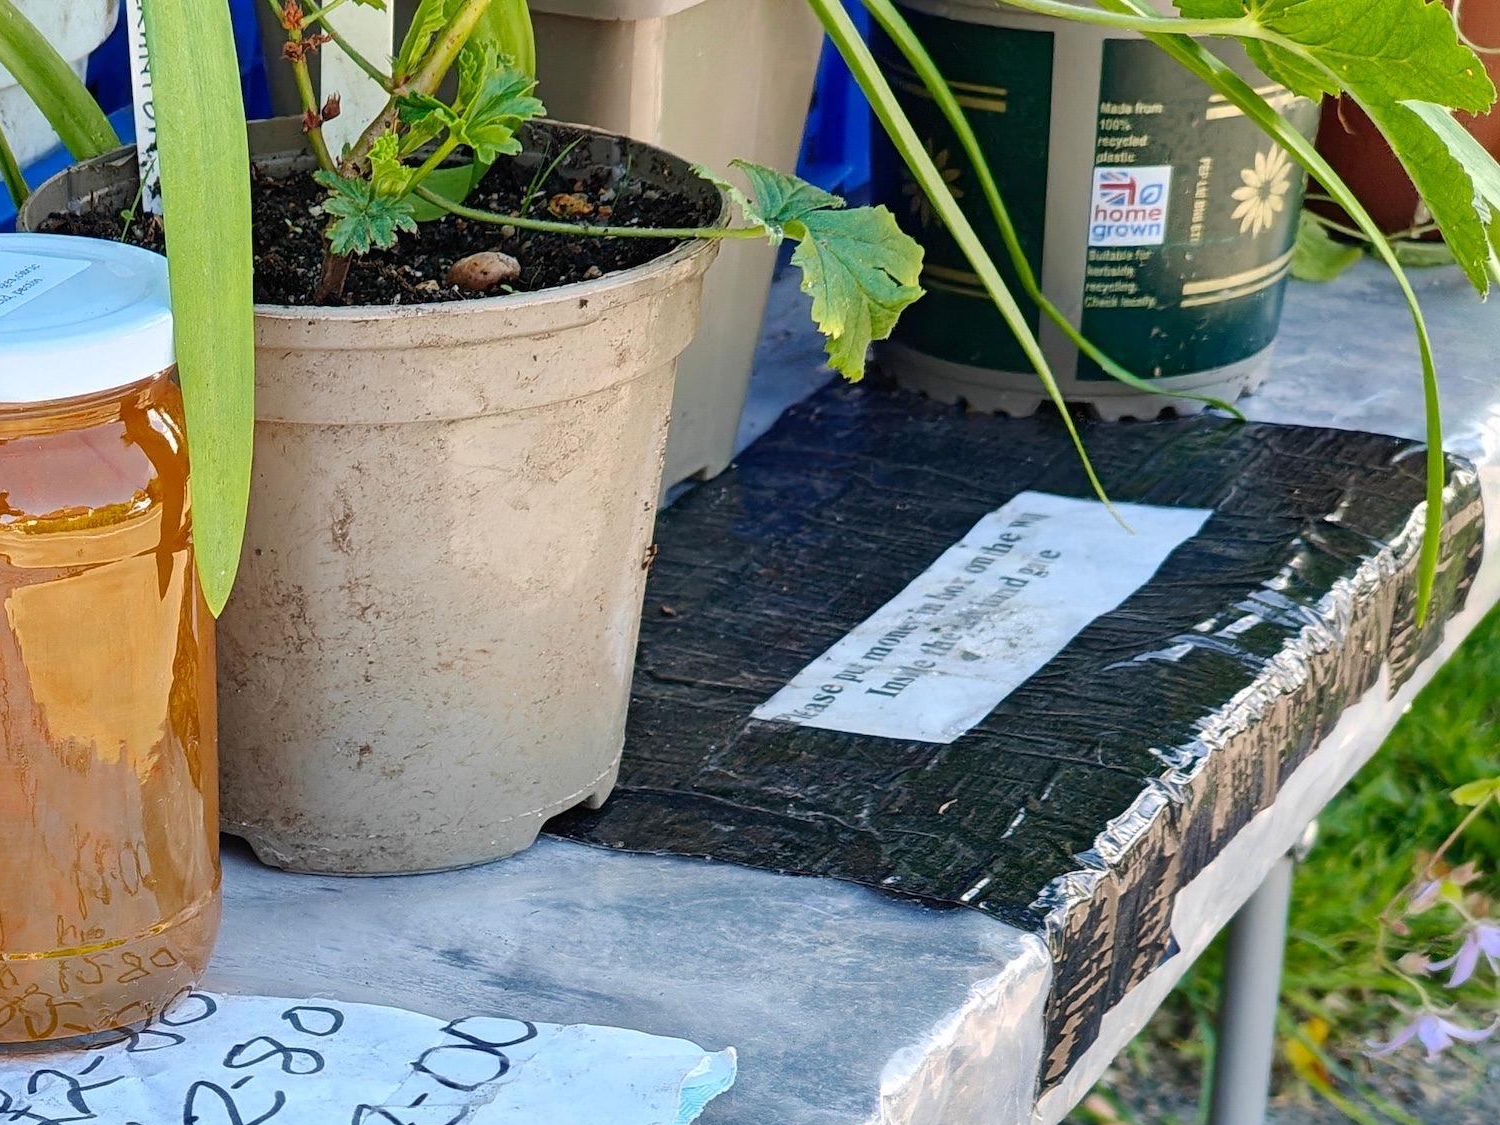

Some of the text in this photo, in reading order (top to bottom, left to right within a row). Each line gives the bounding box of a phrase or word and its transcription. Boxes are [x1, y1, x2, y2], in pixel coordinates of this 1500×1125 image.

[1097, 135, 1148, 149] recycled
[1094, 205, 1162, 222] home
[1091, 223, 1161, 242] grown
[770, 683, 844, 723] Please
[964, 556, 996, 574] on
